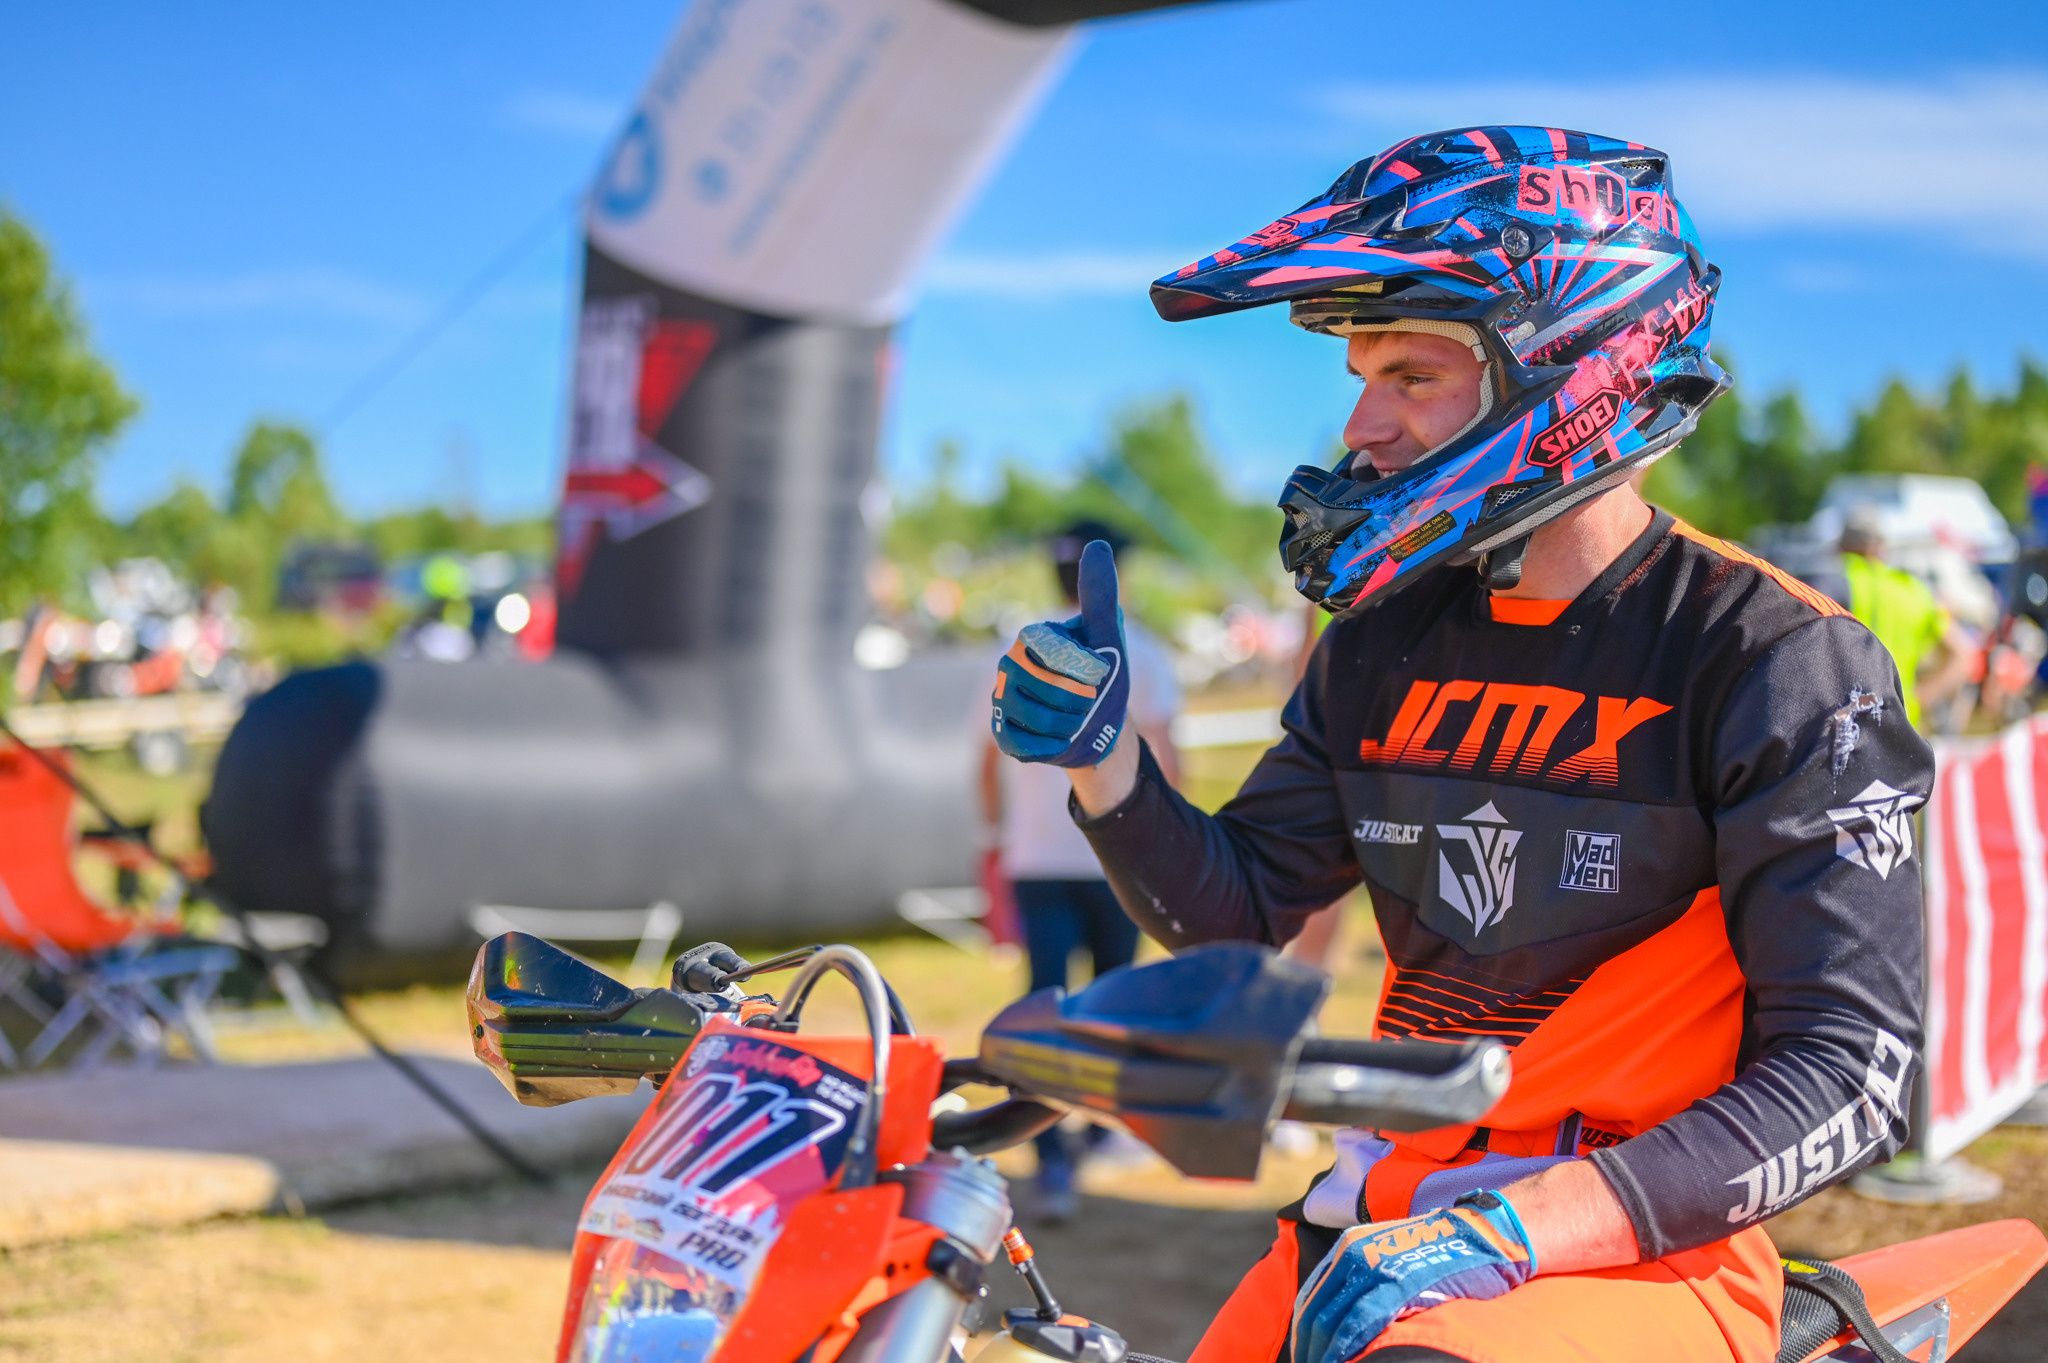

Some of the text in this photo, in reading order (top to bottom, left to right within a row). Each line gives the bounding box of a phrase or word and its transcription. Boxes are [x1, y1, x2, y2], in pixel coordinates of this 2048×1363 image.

[1540, 395, 1615, 461] SHOEI
[1390, 514, 1446, 551] EMERGENCY USE ONLY
[1360, 679, 1674, 788] JCMX
[1353, 819, 1423, 844] JUSTCAT
[677, 1231, 748, 1271] PRO
[1363, 1217, 1456, 1270] KTM
[1380, 1239, 1468, 1281] GoPro
